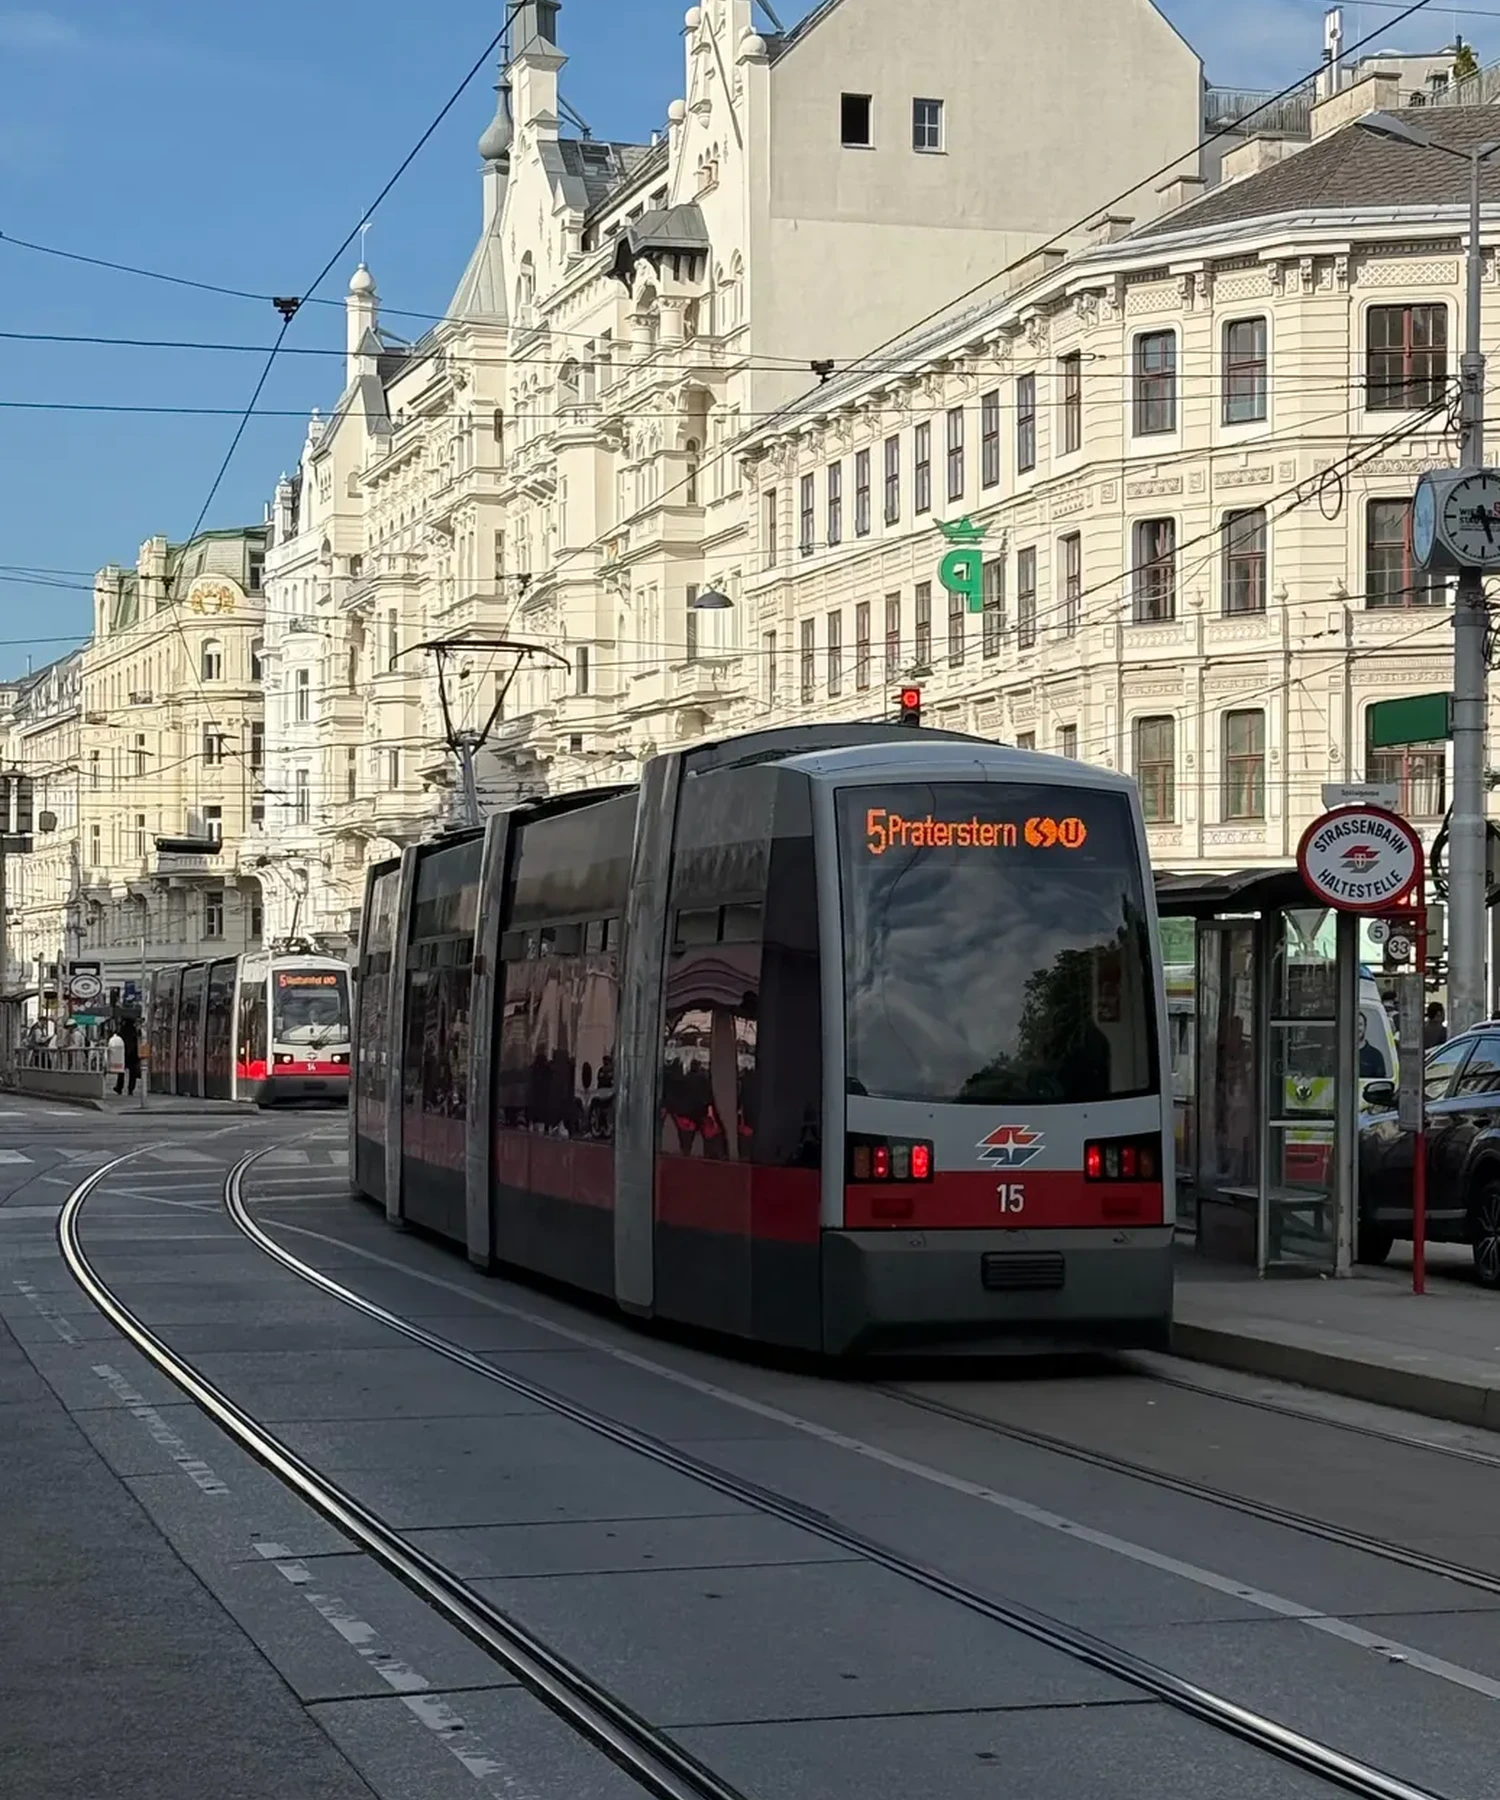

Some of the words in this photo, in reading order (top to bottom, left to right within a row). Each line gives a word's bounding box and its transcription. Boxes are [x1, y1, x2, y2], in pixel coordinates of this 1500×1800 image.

[867, 808, 887, 854] 5
[888, 814, 1017, 847] Praterstern
[1314, 819, 1408, 854] STRASSENBAHN
[1318, 868, 1403, 898] HALTESTELLE
[1374, 926, 1383, 939] 5
[1391, 940, 1409, 954] 33
[996, 1184, 1025, 1212] 15
